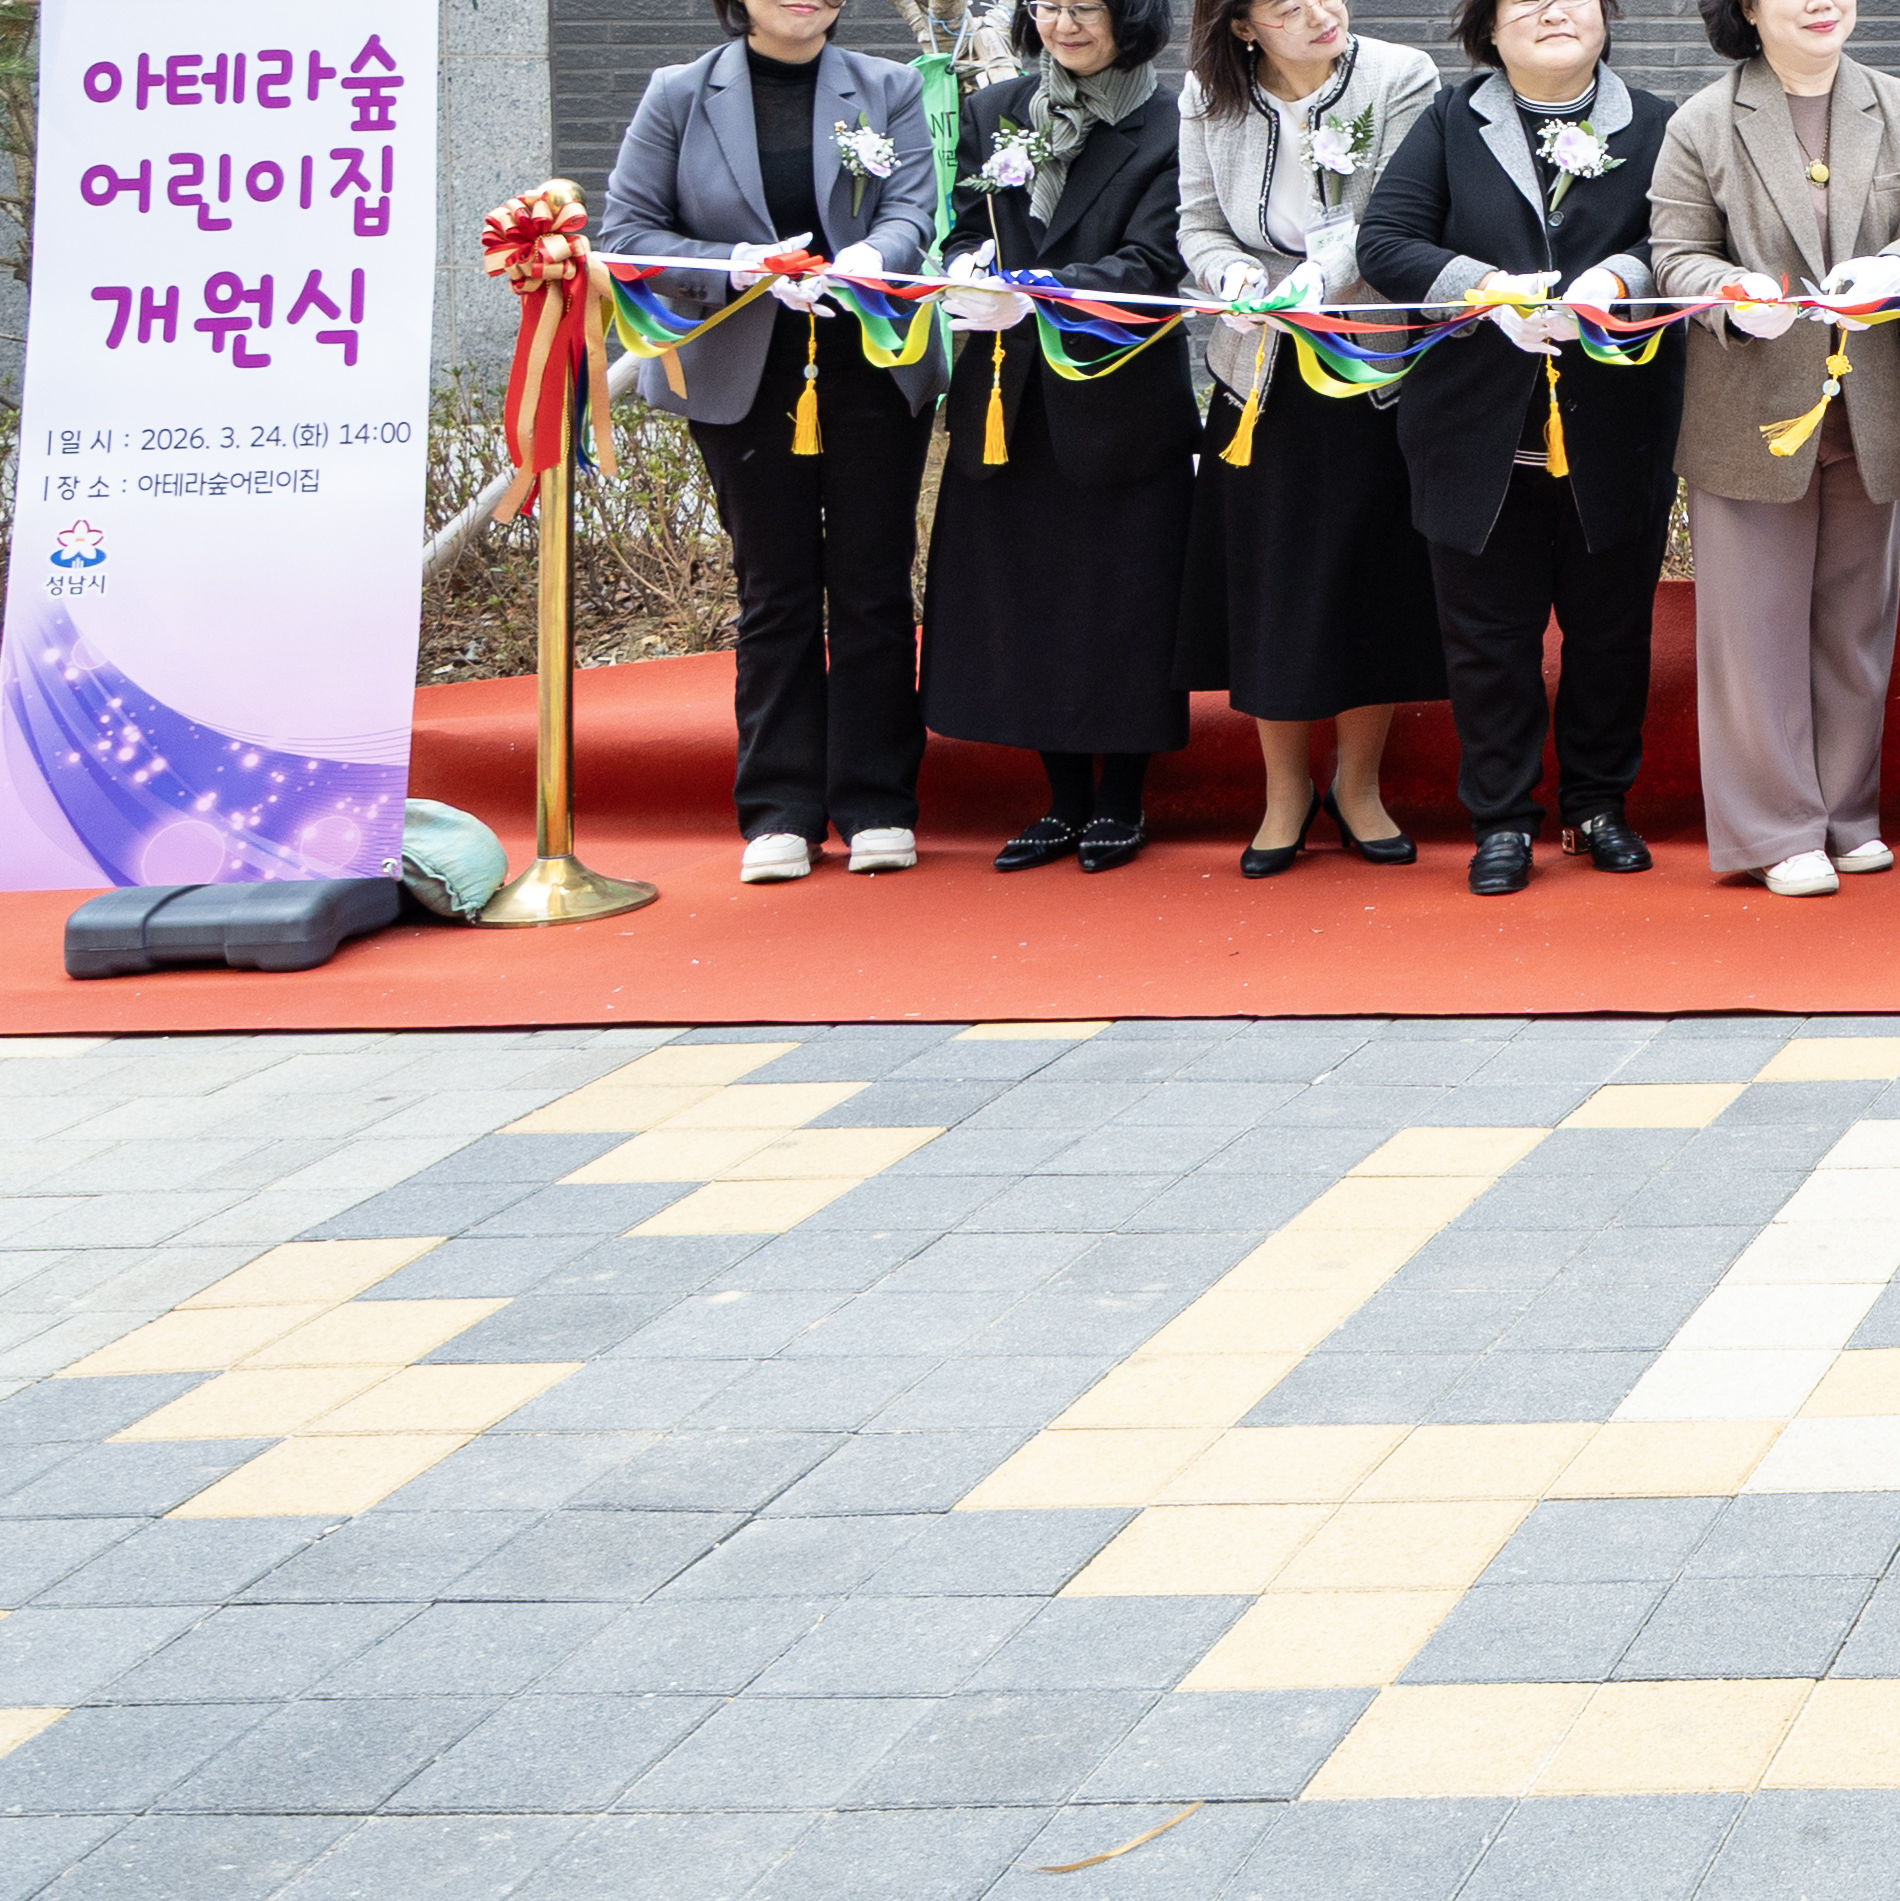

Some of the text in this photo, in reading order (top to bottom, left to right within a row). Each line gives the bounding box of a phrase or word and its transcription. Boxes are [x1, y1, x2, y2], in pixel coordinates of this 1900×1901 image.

[81, 34, 405, 133] 아테라숲
[79, 144, 395, 238] 어린이집
[90, 267, 367, 370] 개원식
[141, 427, 211, 451] 2026.
[219, 426, 241, 450] 3.
[338, 421, 412, 445] 14:00
[137, 468, 320, 497] 아테라숲어린이집
[45, 575, 107, 597] 성남시
